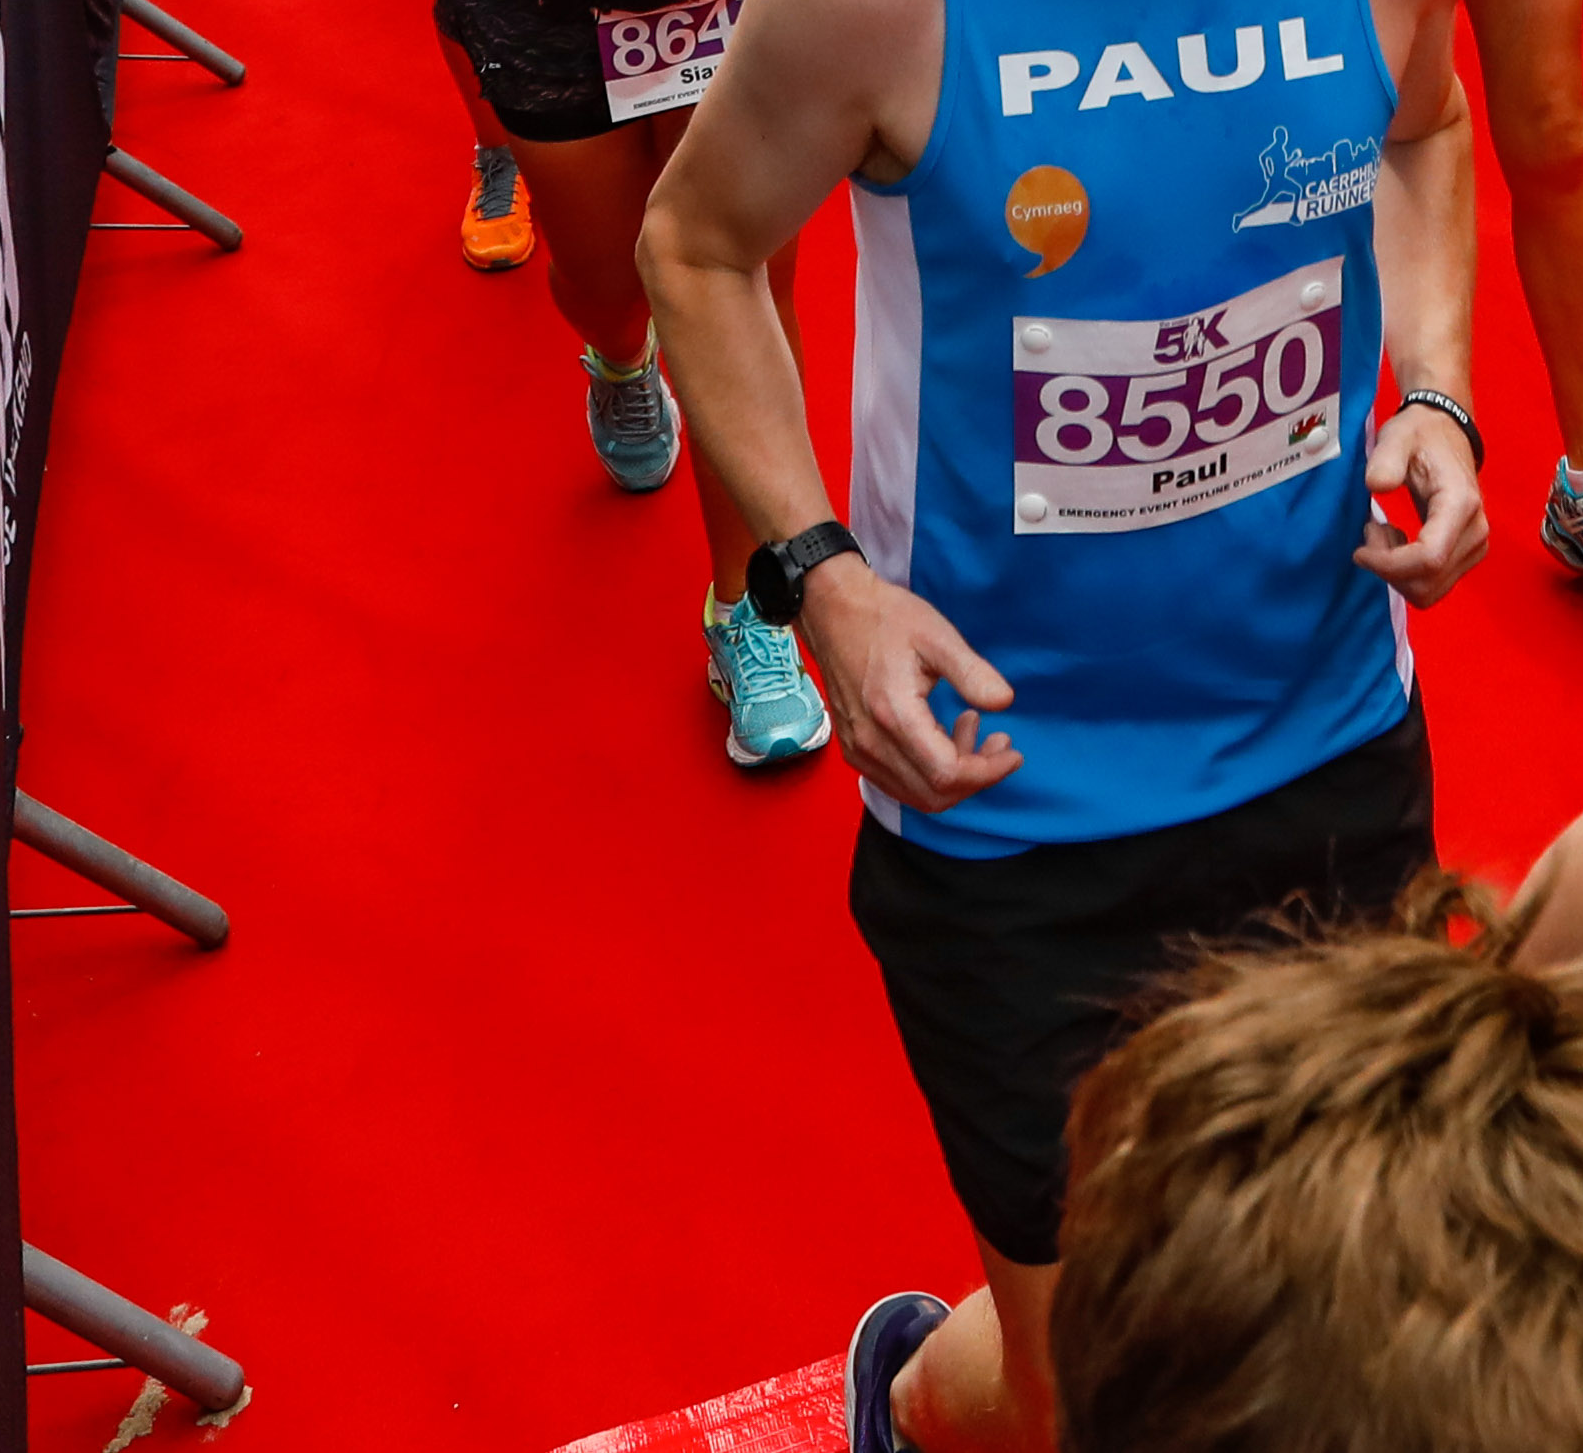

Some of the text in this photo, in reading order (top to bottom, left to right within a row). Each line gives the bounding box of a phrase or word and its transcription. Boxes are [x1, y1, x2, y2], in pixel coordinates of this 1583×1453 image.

[680, 64, 719, 84] Sia
[998, 17, 1345, 117] PAUL
[1012, 200, 1083, 222] Cymraeg
[1153, 309, 1231, 364] 5K
[1035, 321, 1325, 466] 8550
[1408, 391, 1468, 425] WEEKEND
[1152, 451, 1228, 494] Paul
[1058, 507, 1136, 518] EMERGENCY
[1139, 500, 1178, 515] EVENT
[1181, 483, 1230, 505] HOTLINE
